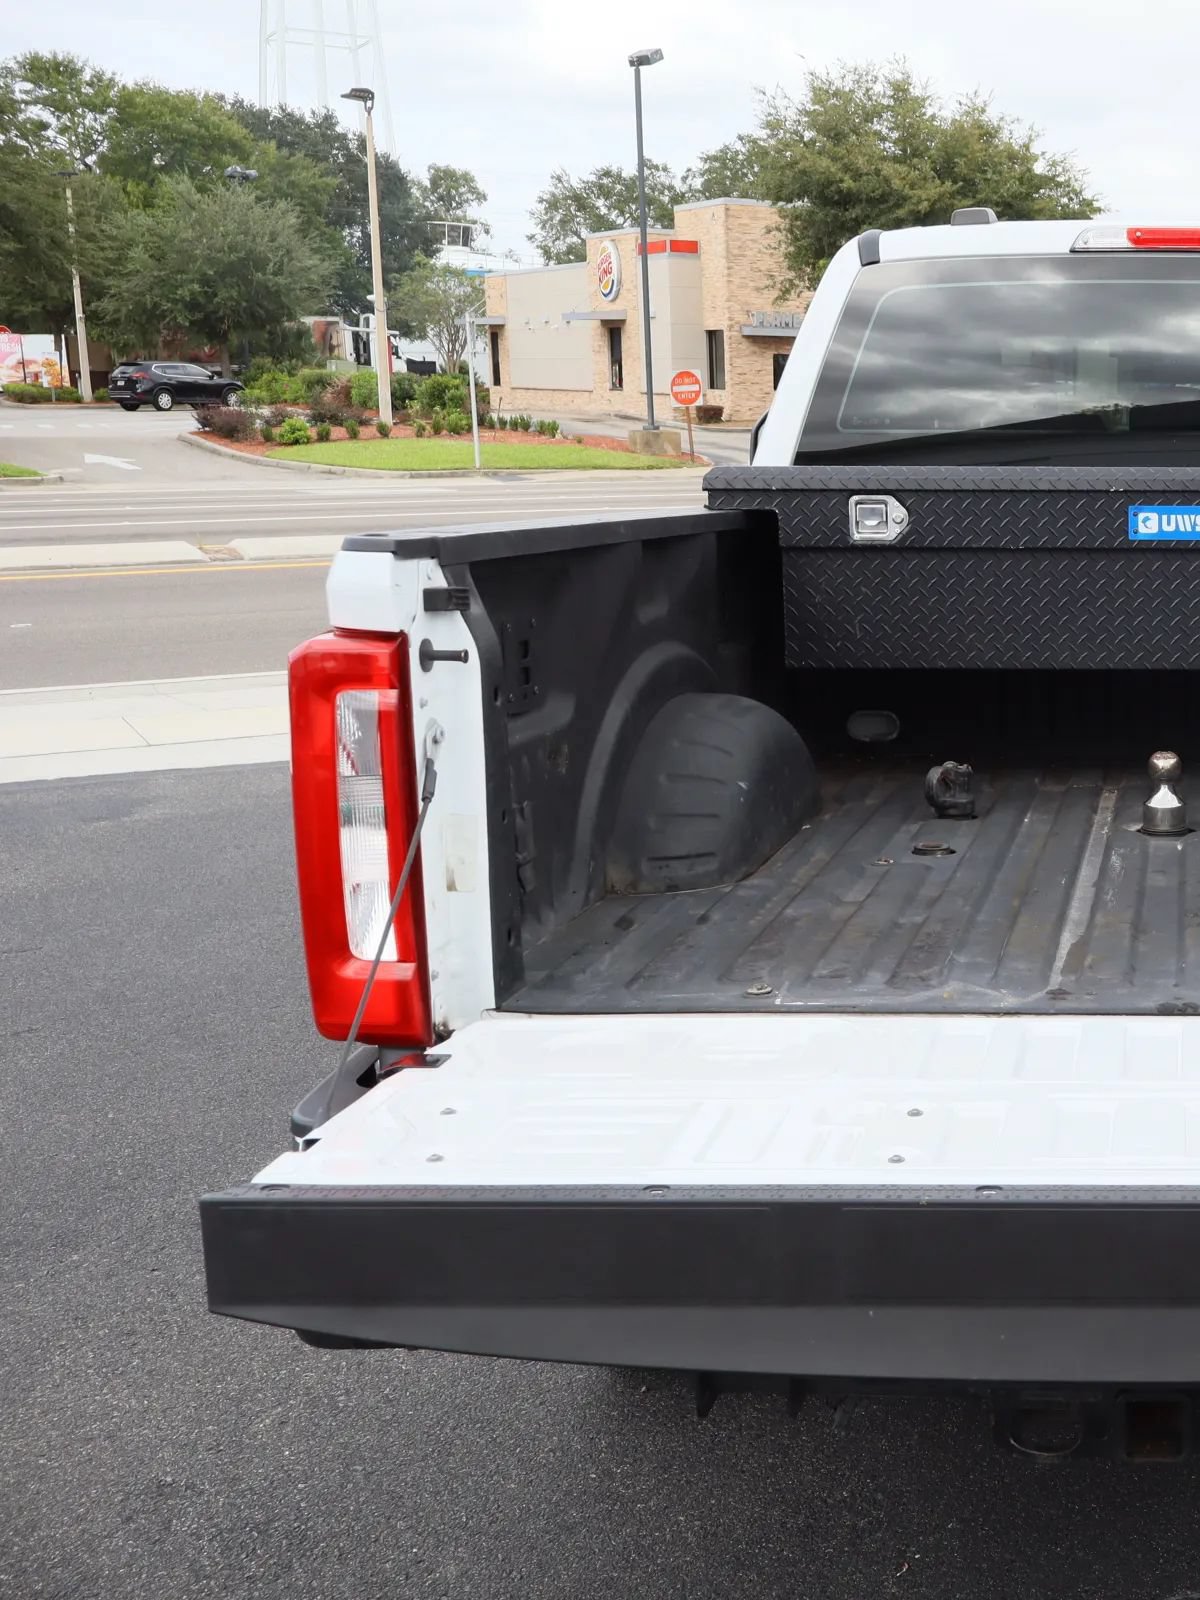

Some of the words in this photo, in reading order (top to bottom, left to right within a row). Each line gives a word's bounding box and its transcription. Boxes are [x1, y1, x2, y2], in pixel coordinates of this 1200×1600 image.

[599, 260, 613, 287] KING
[674, 377, 683, 385] DO
[677, 391, 696, 400] ENTER
